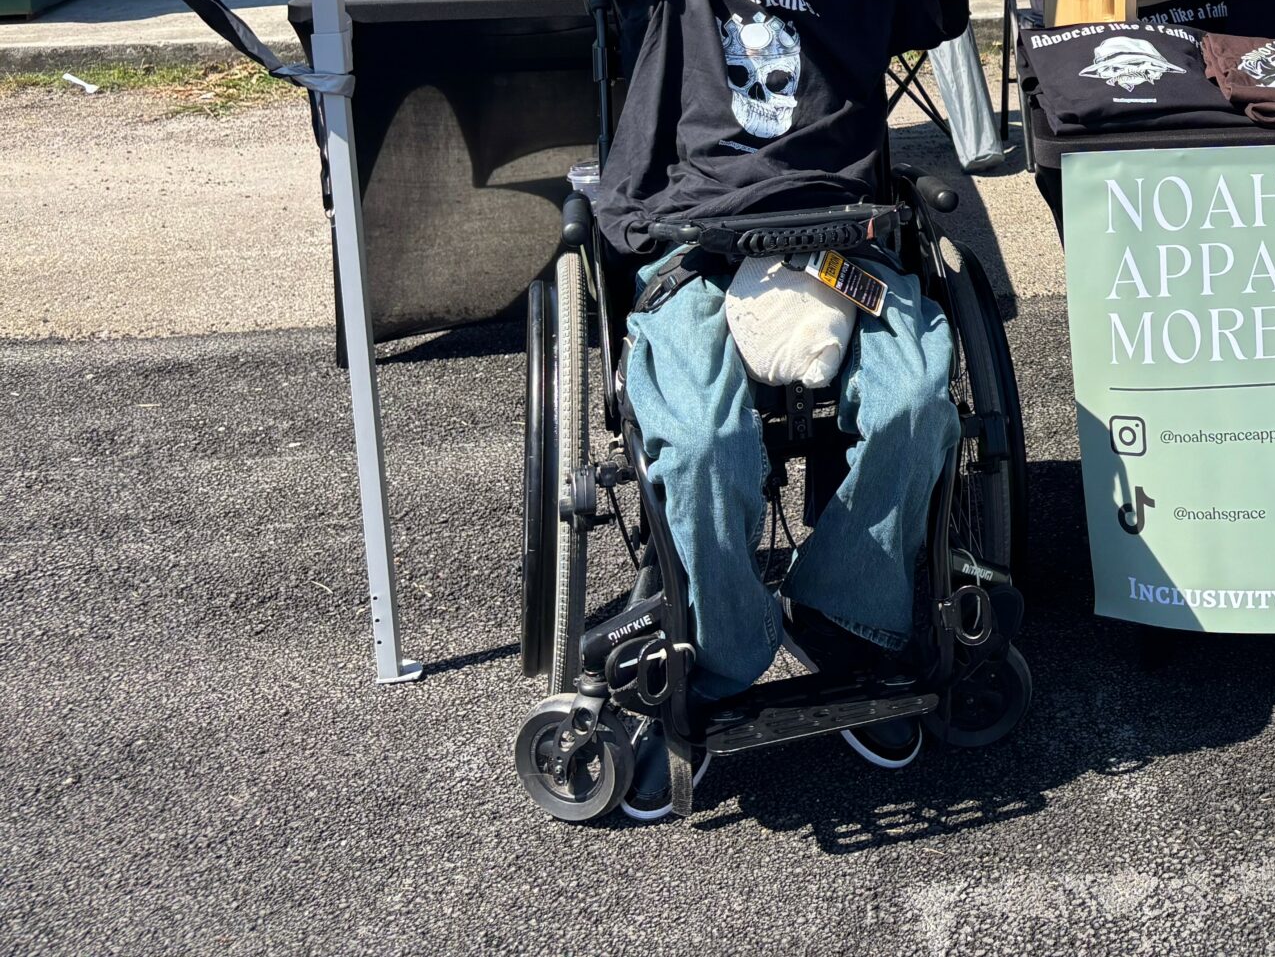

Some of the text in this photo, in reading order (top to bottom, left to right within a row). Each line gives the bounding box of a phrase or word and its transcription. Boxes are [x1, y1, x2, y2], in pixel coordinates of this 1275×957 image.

[1169, 8, 1195, 23] like
[1197, 7, 1206, 20] a
[1031, 25, 1105, 50] Advocate
[1144, 24, 1155, 32] a
[1173, 506, 1266, 522] @noahsgrace
